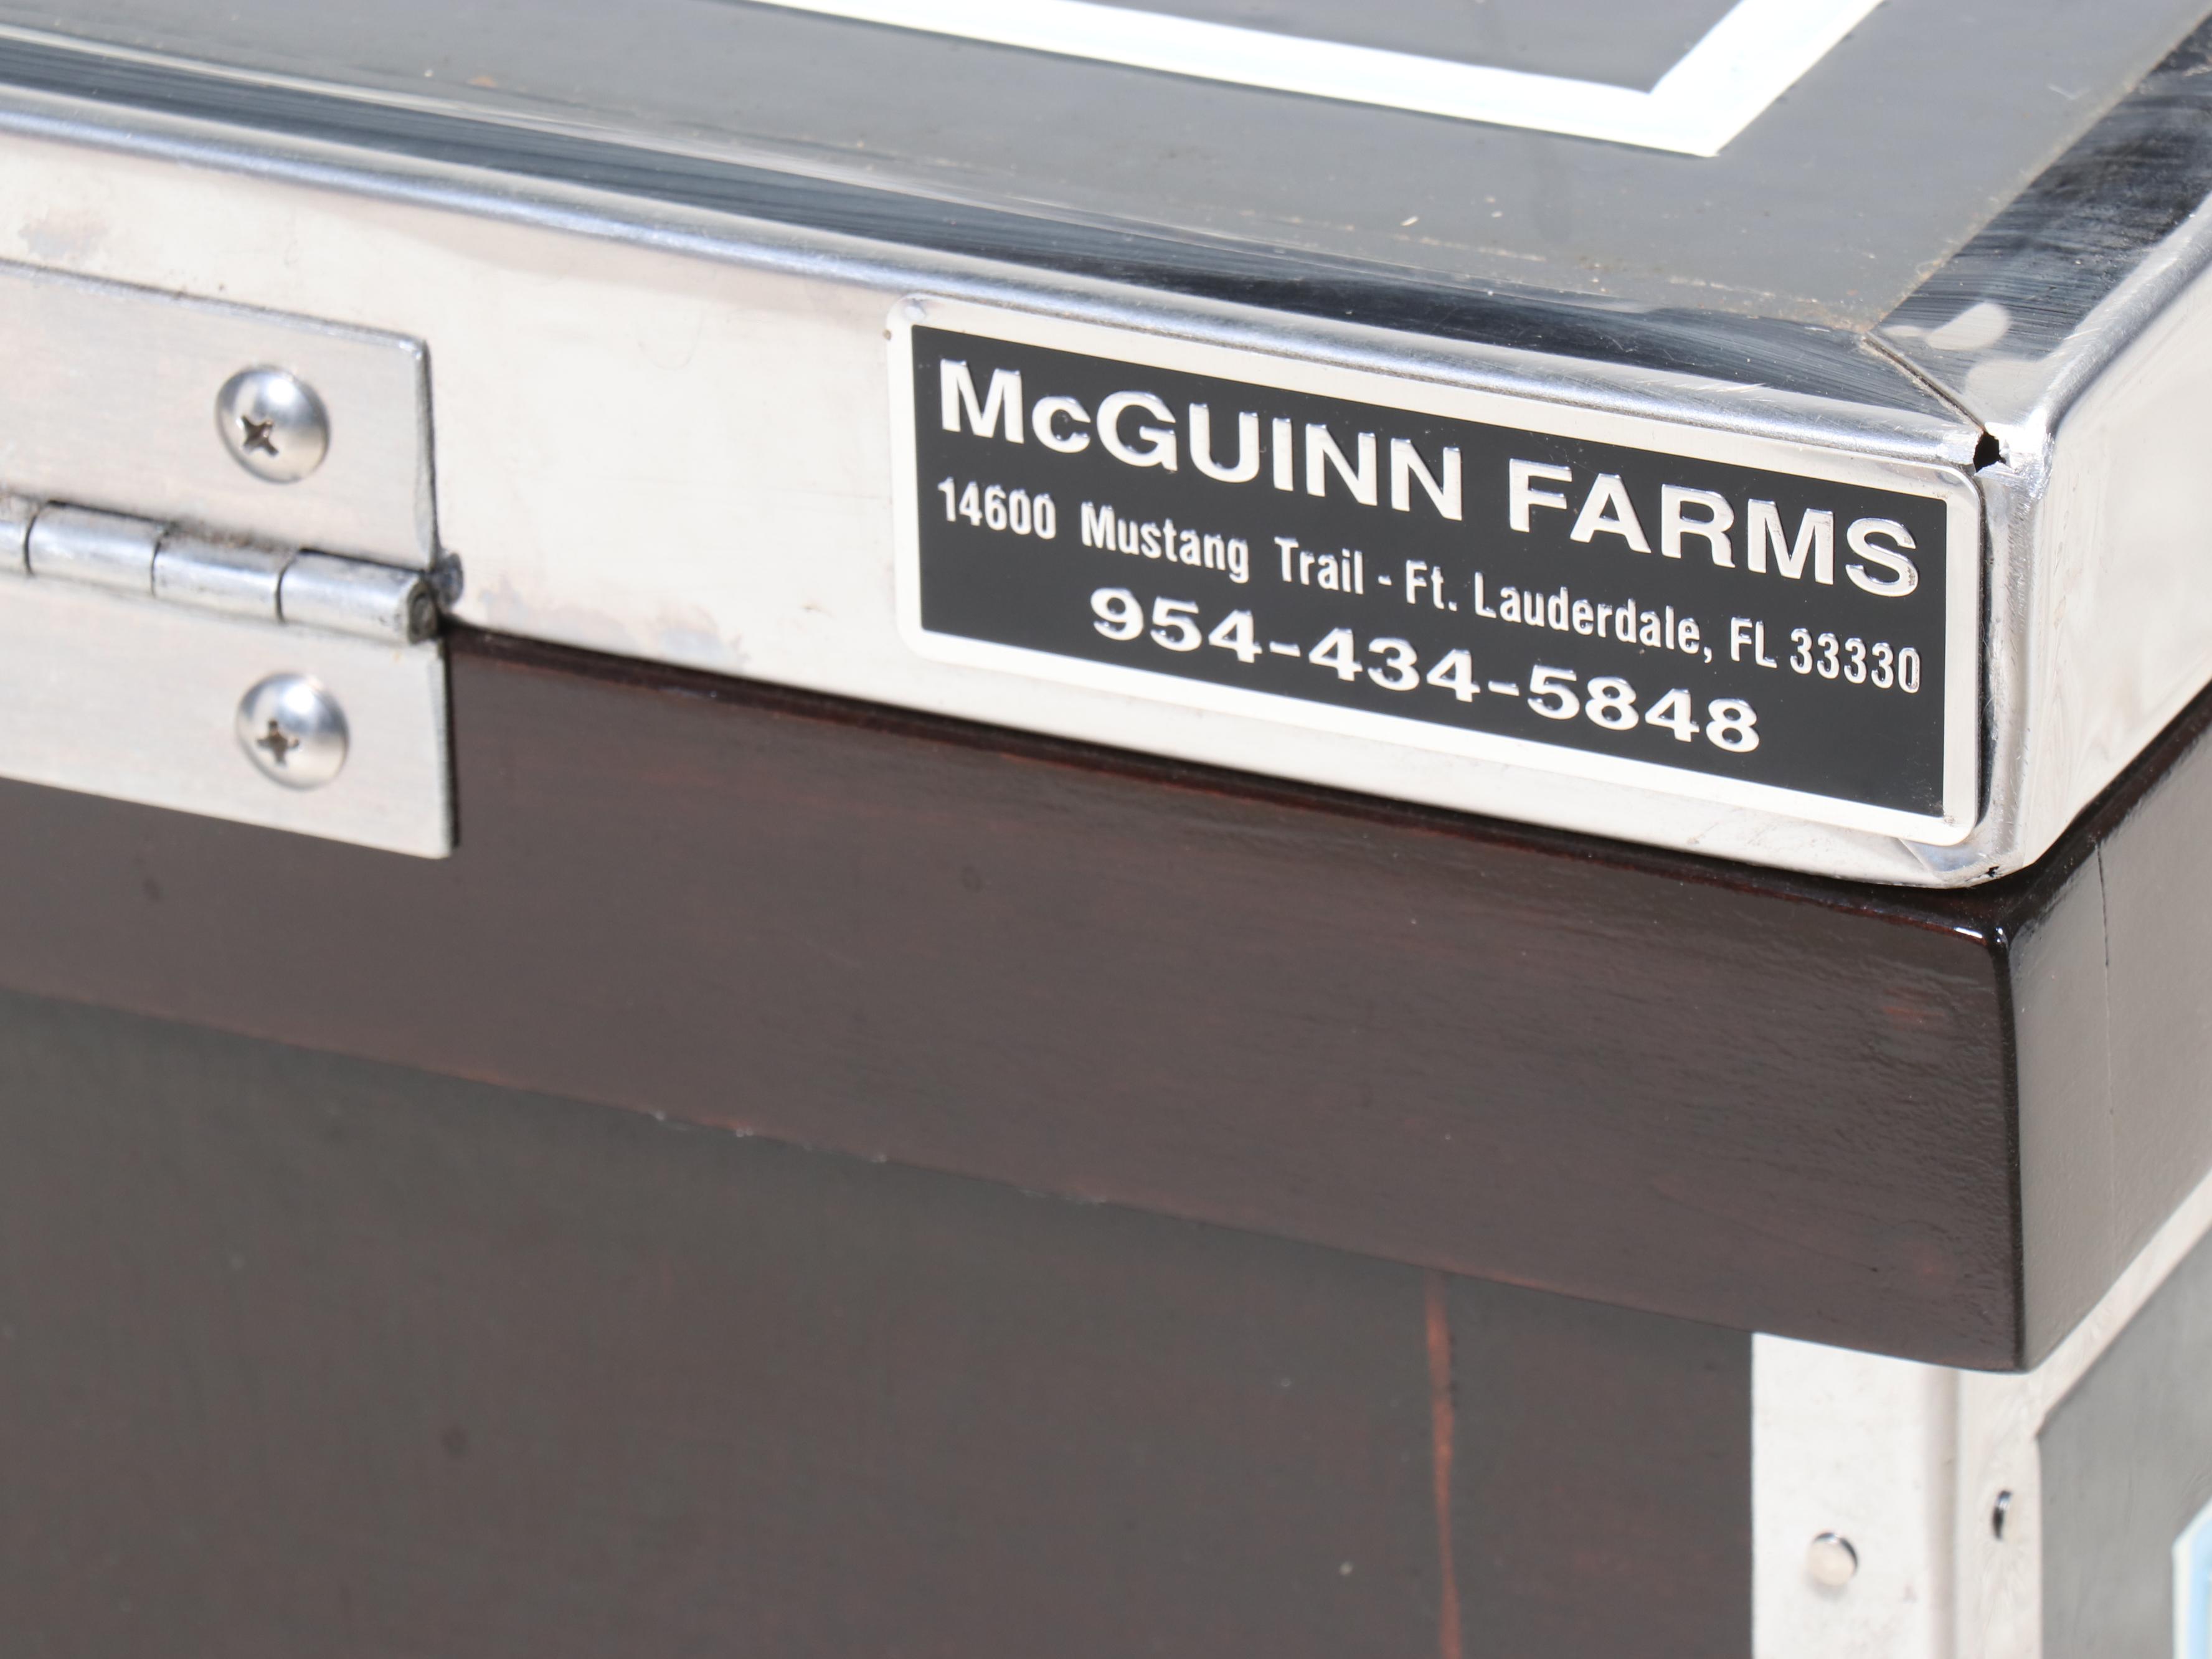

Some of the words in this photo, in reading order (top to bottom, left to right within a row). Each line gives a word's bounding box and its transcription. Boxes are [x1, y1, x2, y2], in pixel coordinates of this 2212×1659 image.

[937, 476, 1057, 541] 14600
[1080, 501, 1250, 585] Mustang
[1273, 536, 1364, 595] Trail
[1405, 559, 1458, 612] Ft.
[1473, 571, 1713, 664] Lauderdale,
[1729, 616, 1778, 669] FL
[1789, 626, 1921, 694] 33330
[939, 358, 1463, 522] McGUINN
[1508, 457, 1919, 598] FARMS
[1089, 587, 1761, 754] 954-434-5848
